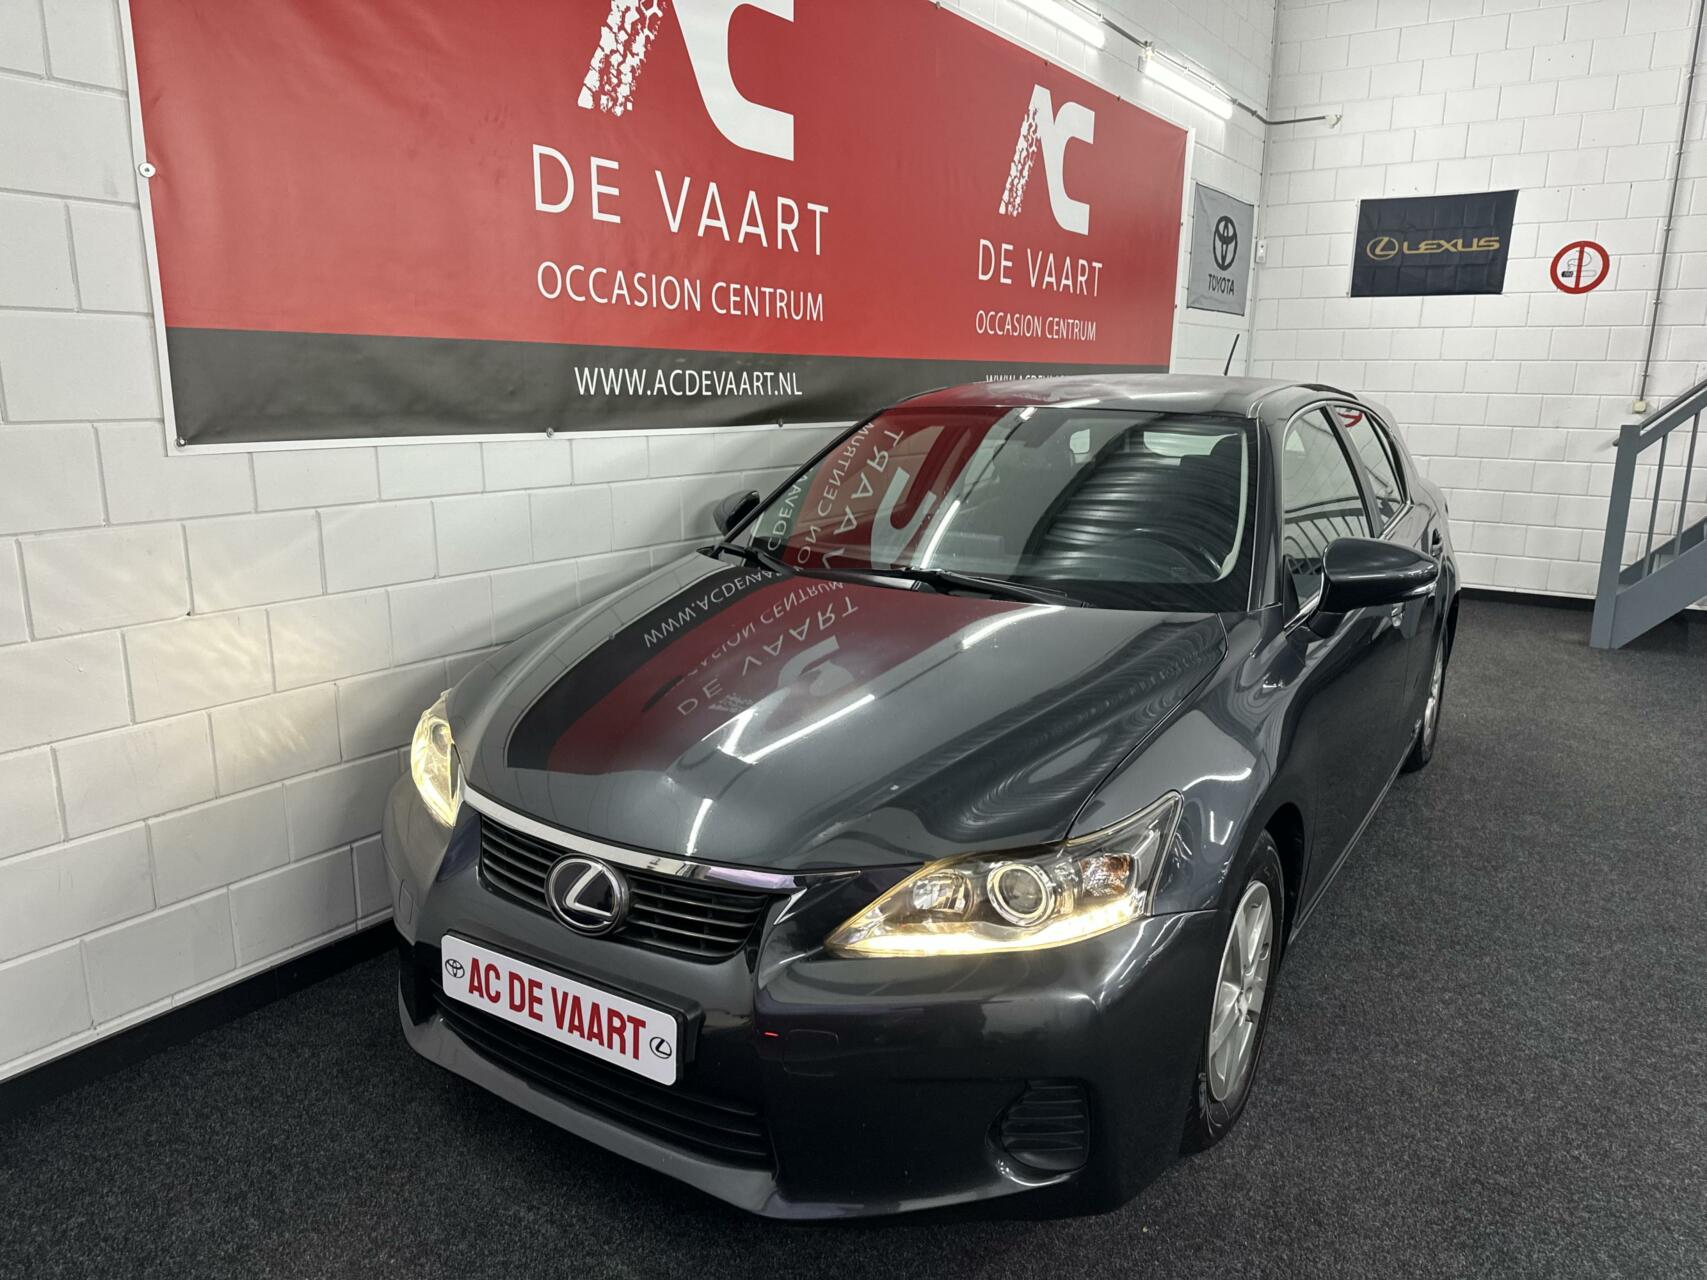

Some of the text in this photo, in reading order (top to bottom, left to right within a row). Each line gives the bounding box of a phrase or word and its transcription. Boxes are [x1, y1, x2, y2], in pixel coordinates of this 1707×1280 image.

[532, 143, 829, 256] DE VAART
[978, 238, 1103, 297] DE VAART
[1402, 236, 1500, 255] LEXUS
[537, 261, 824, 322] OCCASION CENTRUM
[1208, 273, 1235, 296] TOYOTA
[975, 309, 1097, 342] OCCASION CENTRUM
[574, 366, 803, 397] WWW.ACDEVAART.NL
[468, 957, 501, 1004] AC
[508, 970, 543, 1022] DE
[550, 985, 646, 1061] VAART
